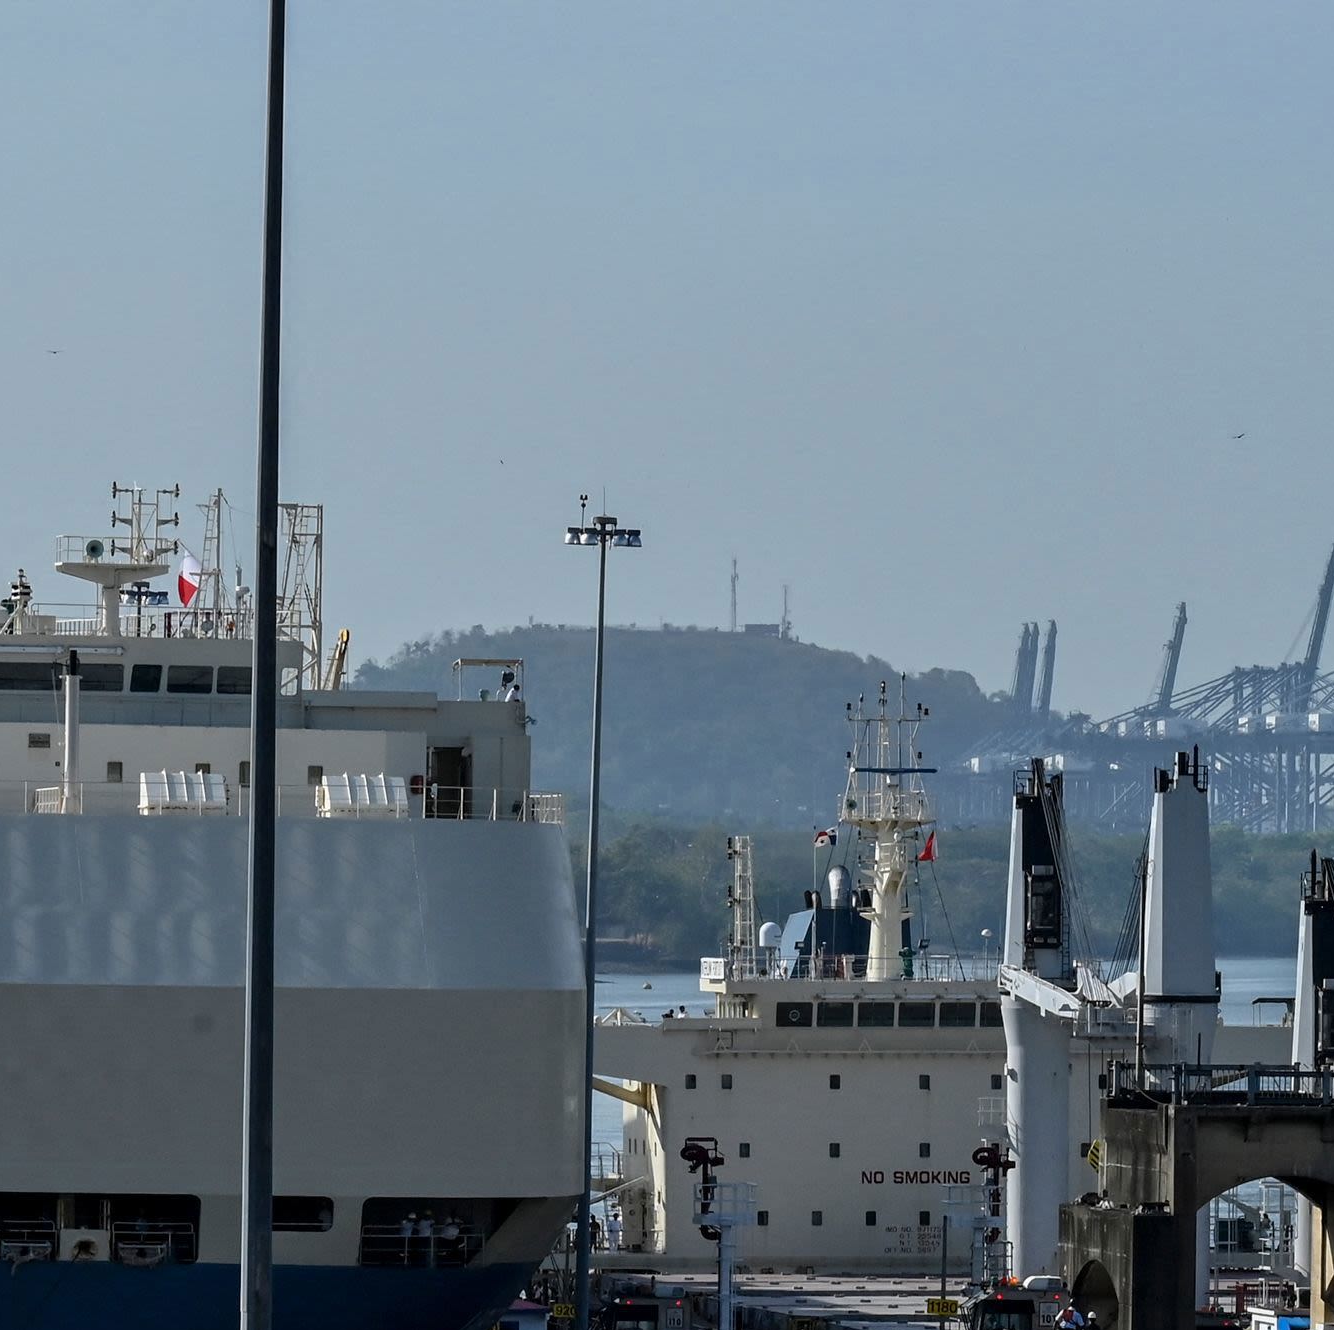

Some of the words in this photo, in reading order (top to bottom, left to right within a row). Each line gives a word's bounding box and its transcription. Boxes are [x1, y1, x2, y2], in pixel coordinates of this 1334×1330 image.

[861, 1171, 884, 1184] NO
[893, 1171, 971, 1184] SMOKING
[928, 1301, 958, 1314] 1180
